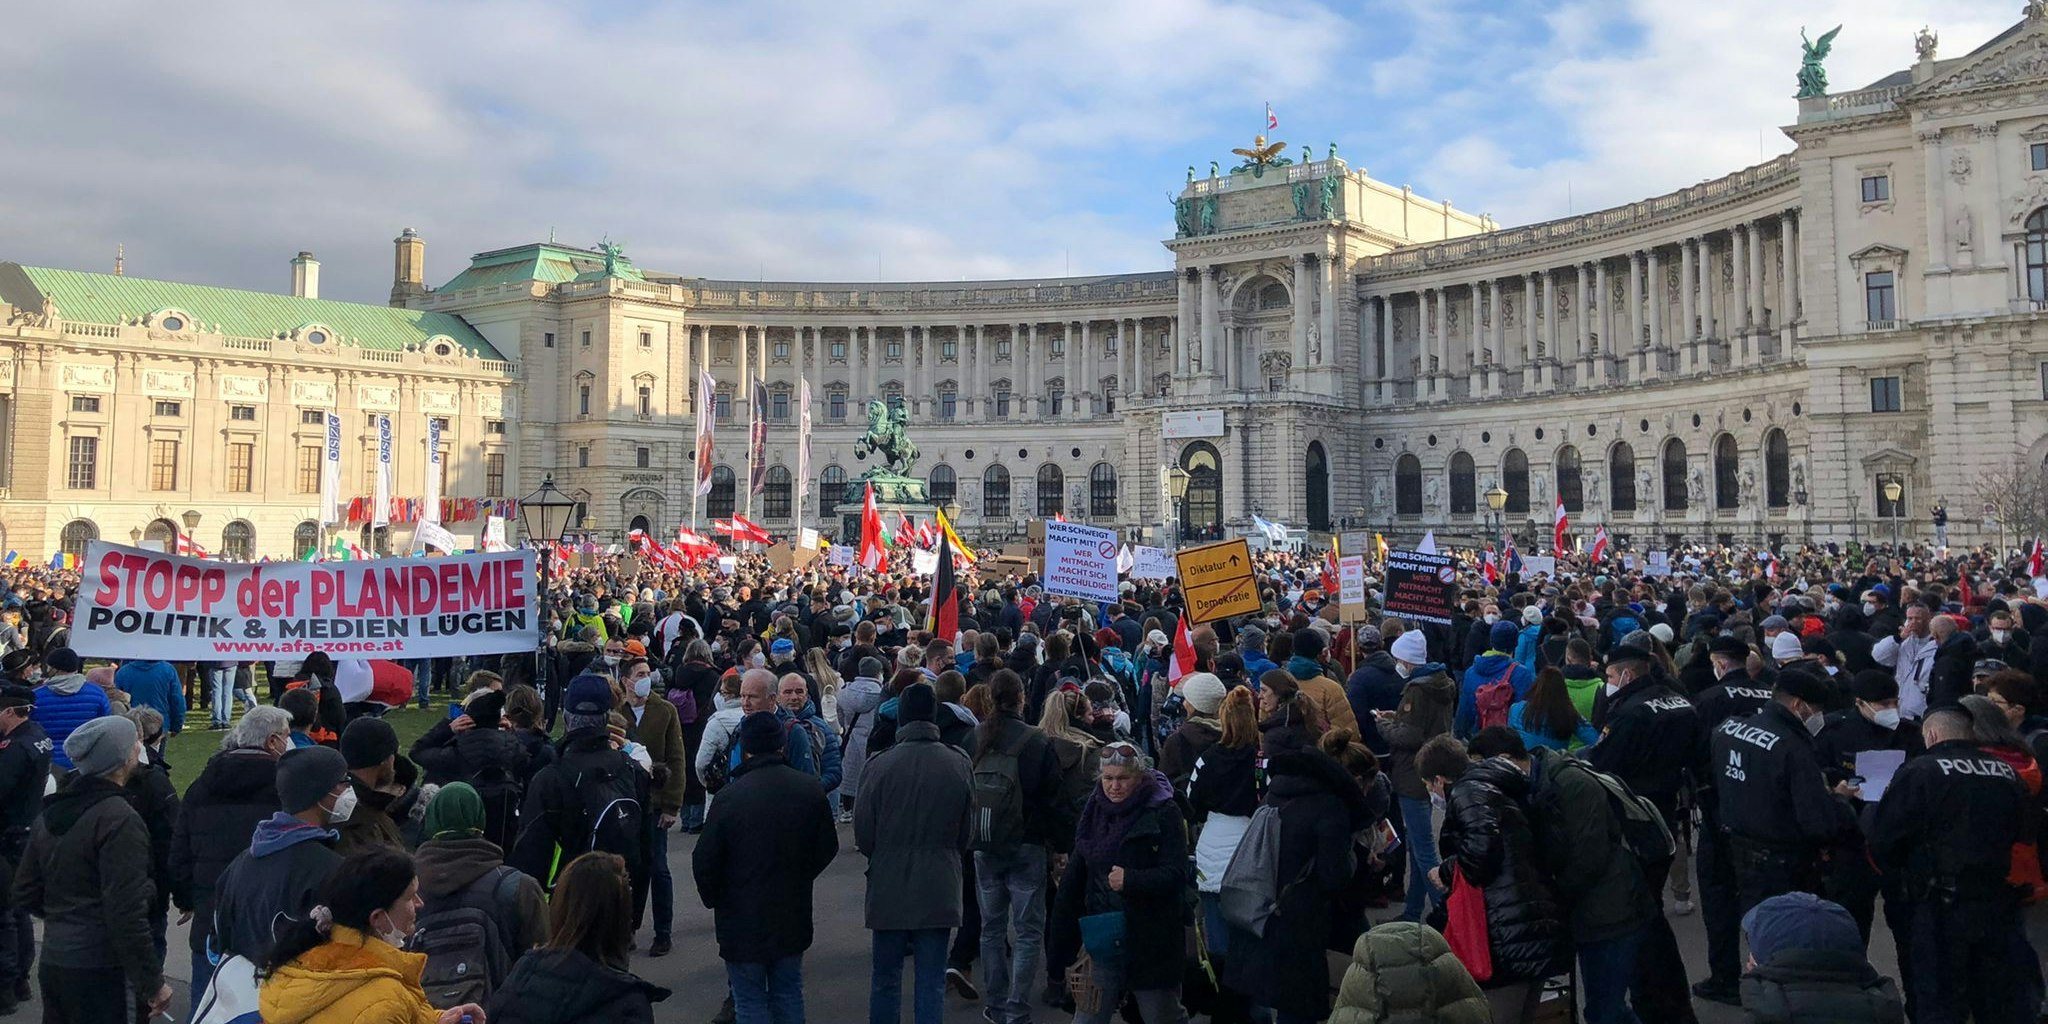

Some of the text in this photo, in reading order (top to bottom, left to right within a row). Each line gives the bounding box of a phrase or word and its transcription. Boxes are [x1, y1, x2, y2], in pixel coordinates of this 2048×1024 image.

[1048, 523, 1109, 540] WER SCHWEIGT
[1048, 534, 1078, 546] MACHT
[1079, 538, 1097, 549] MIT!
[1073, 549, 1093, 558] WER
[1390, 551, 1451, 565] WER SCHWEIGT
[1060, 556, 1105, 570] MITMACHT
[1190, 561, 1227, 576] Diktatur
[1388, 560, 1437, 574] MACHT MIT!
[1058, 566, 1108, 580] MACHT SICH
[1413, 574, 1431, 582] WER
[94, 551, 526, 618] STOPP der PLANDEMIE
[1050, 574, 1114, 591] MITSCHULDIG!!!
[1398, 583, 1442, 593] MITMACHT
[1047, 587, 1117, 603] NEIN ZUM IMPFZWANG
[1196, 591, 1250, 610] Demokratie
[1394, 592, 1424, 601] MACHT
[87, 606, 527, 639] POLITIK & MEDIEN LÜGEN
[212, 639, 404, 653] www.afa-zone.at
[1718, 719, 1780, 751] POLIZEI
[1729, 749, 1742, 768] N
[1725, 765, 1746, 782] 230
[1936, 758, 2017, 781] POLIZEI
